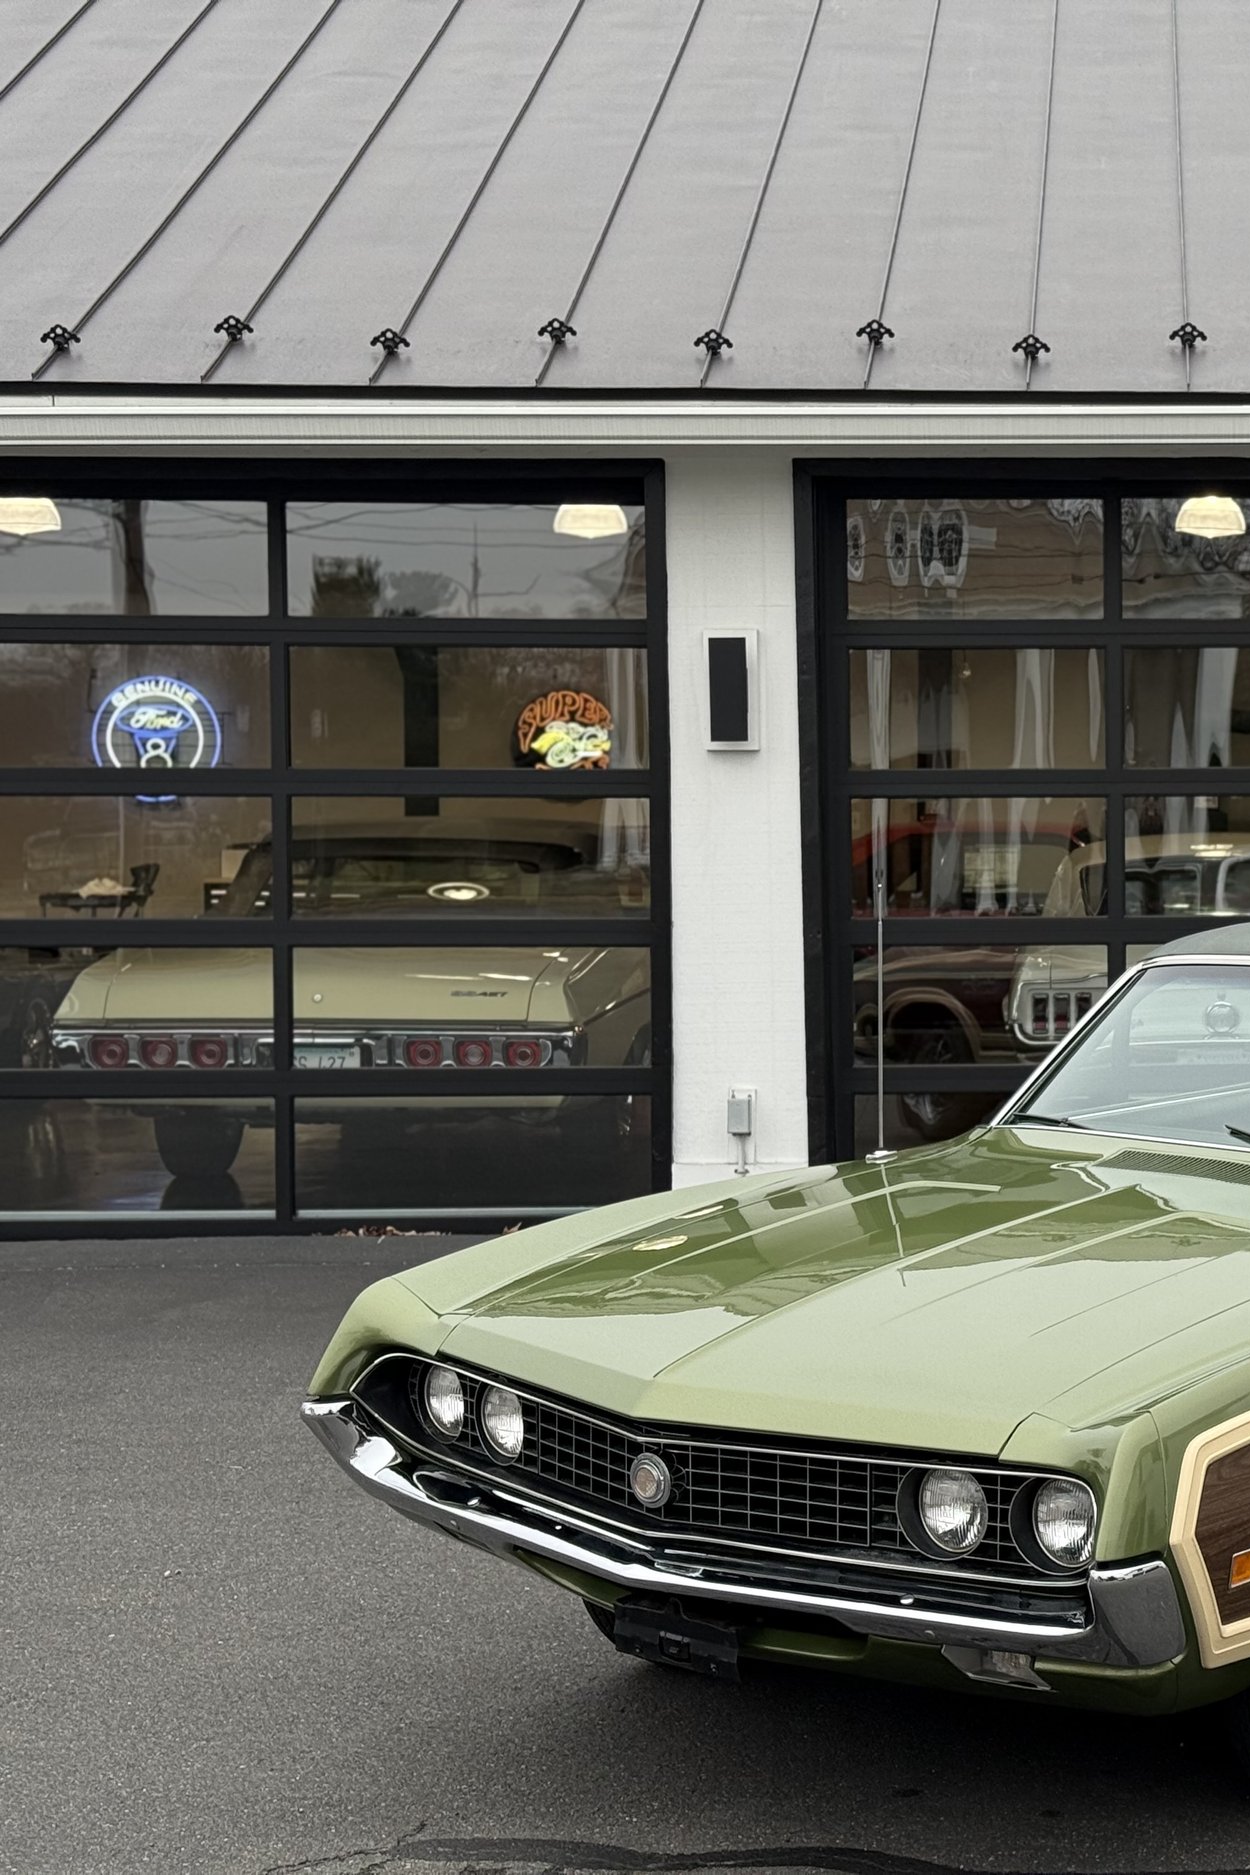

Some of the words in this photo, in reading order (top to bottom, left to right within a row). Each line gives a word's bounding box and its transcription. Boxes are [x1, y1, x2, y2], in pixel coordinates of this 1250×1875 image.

[111, 679, 197, 707] GENUINE
[130, 707, 182, 729] Ford
[518, 690, 614, 753] SUPER
